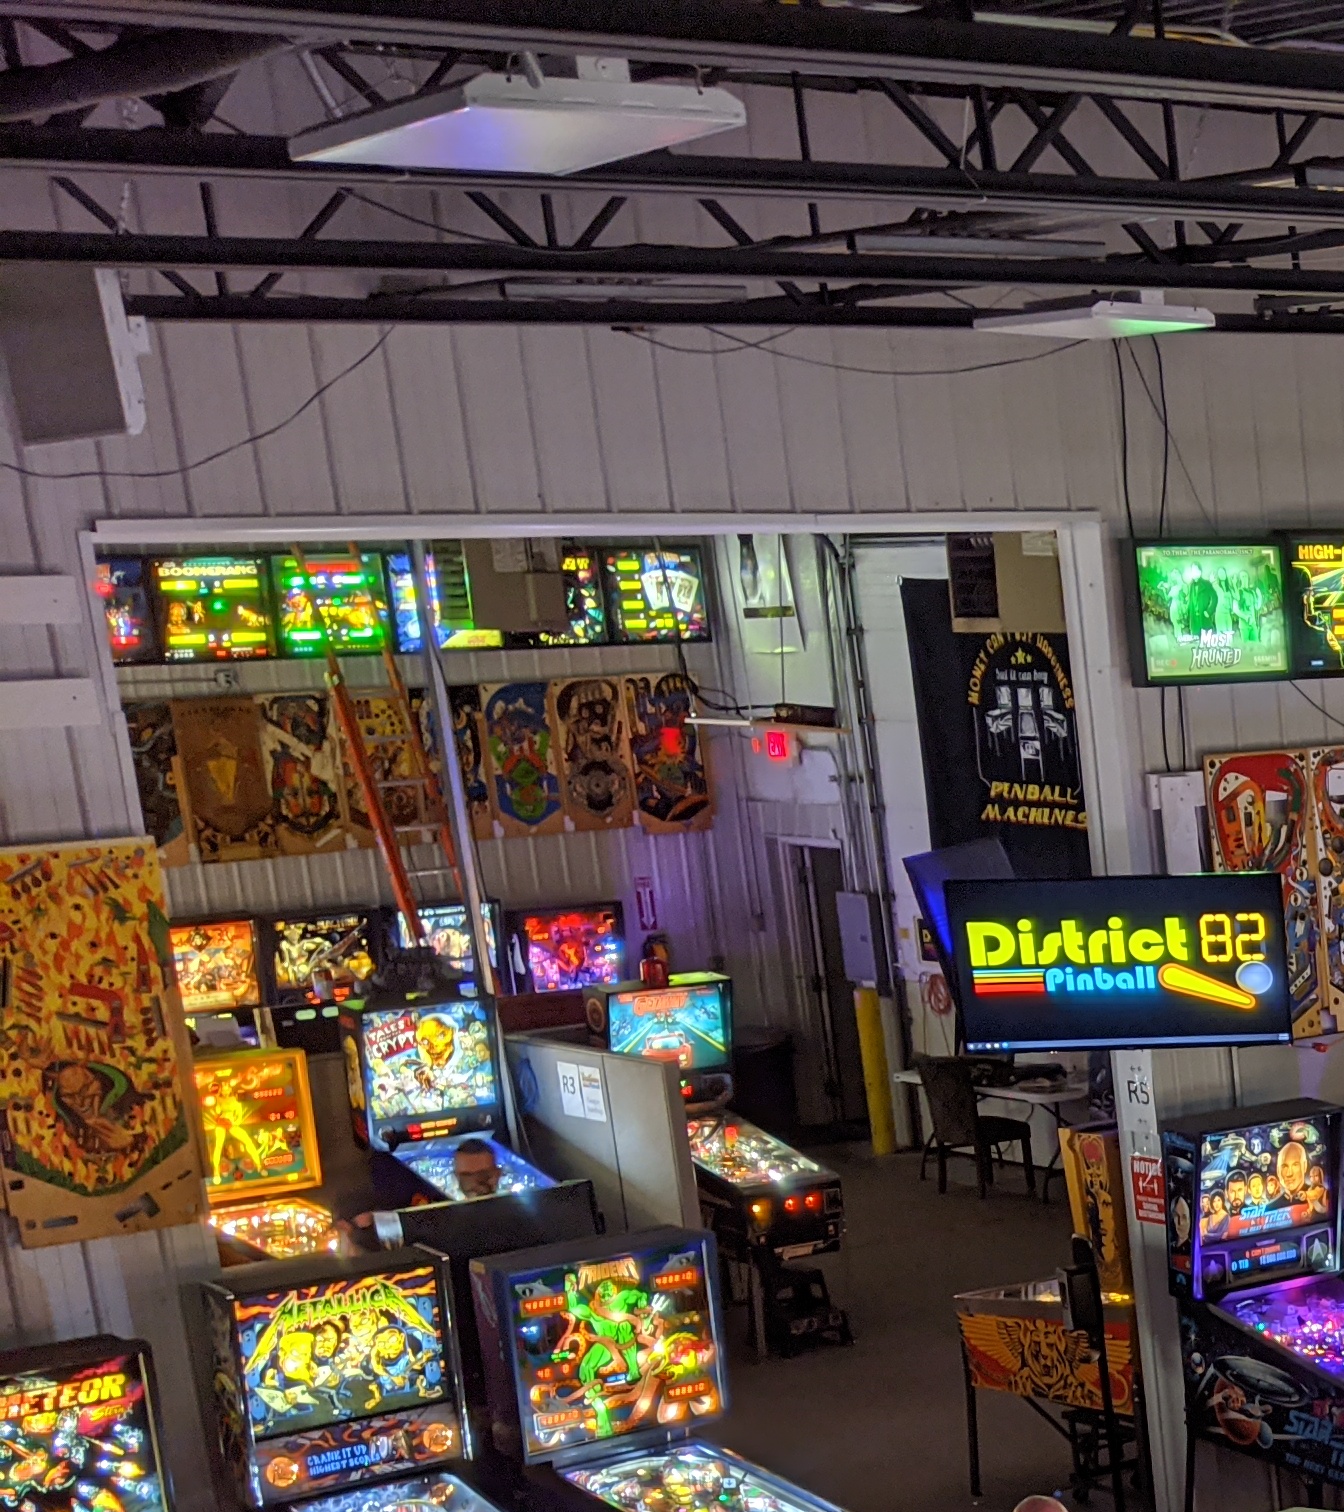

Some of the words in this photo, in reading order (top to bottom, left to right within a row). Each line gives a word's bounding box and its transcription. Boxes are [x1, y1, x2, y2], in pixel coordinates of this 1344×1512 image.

[158, 565, 257, 578] BOOMERANG
[1200, 629, 1235, 648] MOST
[1190, 648, 1242, 671] HAUNTED
[990, 781, 1079, 805] PINBALL
[981, 804, 1088, 830] MACHINES
[965, 916, 1189, 967] District
[1199, 913, 1266, 963] 82
[1045, 965, 1156, 992] Pinball
[369, 1021, 405, 1042] TALES
[372, 1035, 417, 1058] CRYPT
[562, 1075, 576, 1095] R3
[1127, 1080, 1150, 1105] R5
[578, 1256, 640, 1288] TRIDENT
[245, 1277, 437, 1374] METALLICA
[90, 1405, 125, 1421] Stern
[1283, 1410, 1334, 1443] STAR
[307, 1450, 342, 1466] CRANK
[341, 1447, 352, 1460] IT
[353, 1443, 367, 1457] UP
[309, 1461, 348, 1476] HIGHEST
